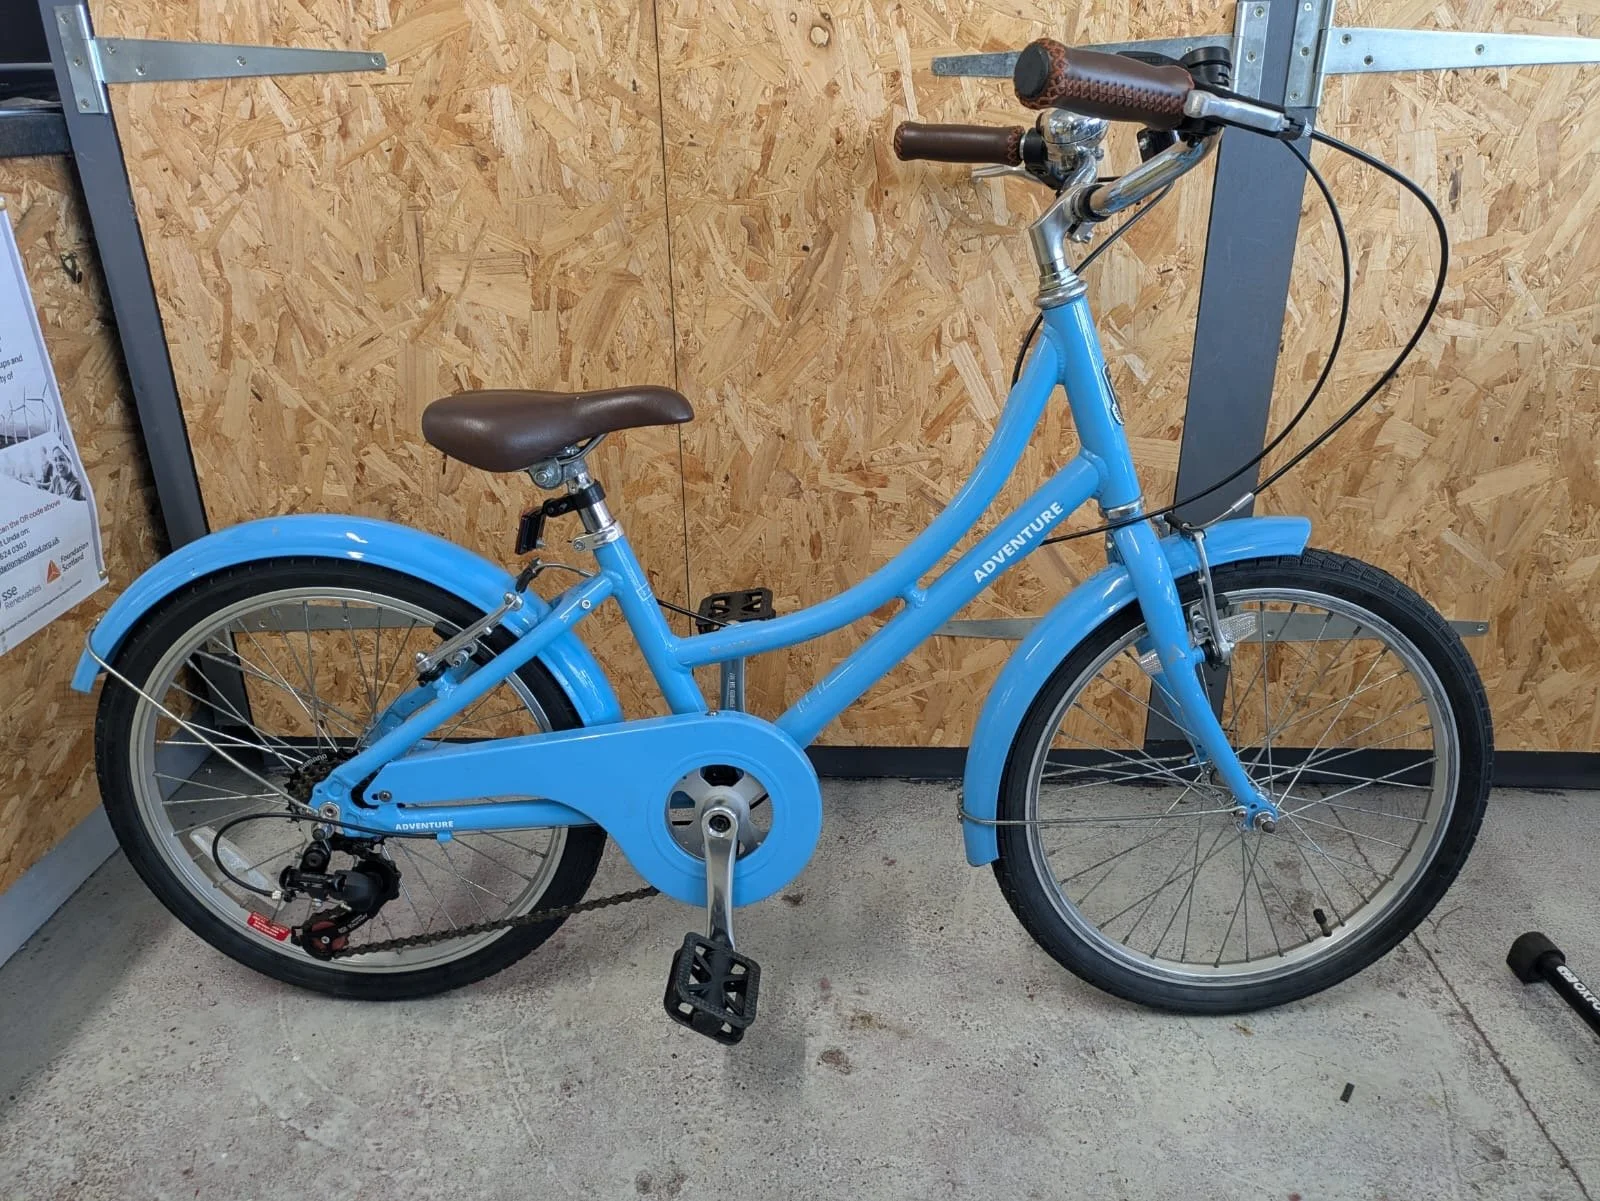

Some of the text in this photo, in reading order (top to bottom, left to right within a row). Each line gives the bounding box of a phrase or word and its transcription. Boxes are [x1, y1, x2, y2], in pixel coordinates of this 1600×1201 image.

[11, 352, 23, 365] and
[9, 518, 20, 529] the
[29, 506, 44, 519] code
[44, 499, 61, 512] above
[3, 532, 20, 545] Linda
[974, 501, 1064, 584] ADVENTURE
[60, 542, 89, 562] Foundation
[61, 552, 85, 571] Scotland
[4, 584, 42, 609] Renewables
[395, 820, 454, 831] ADVENTURE
